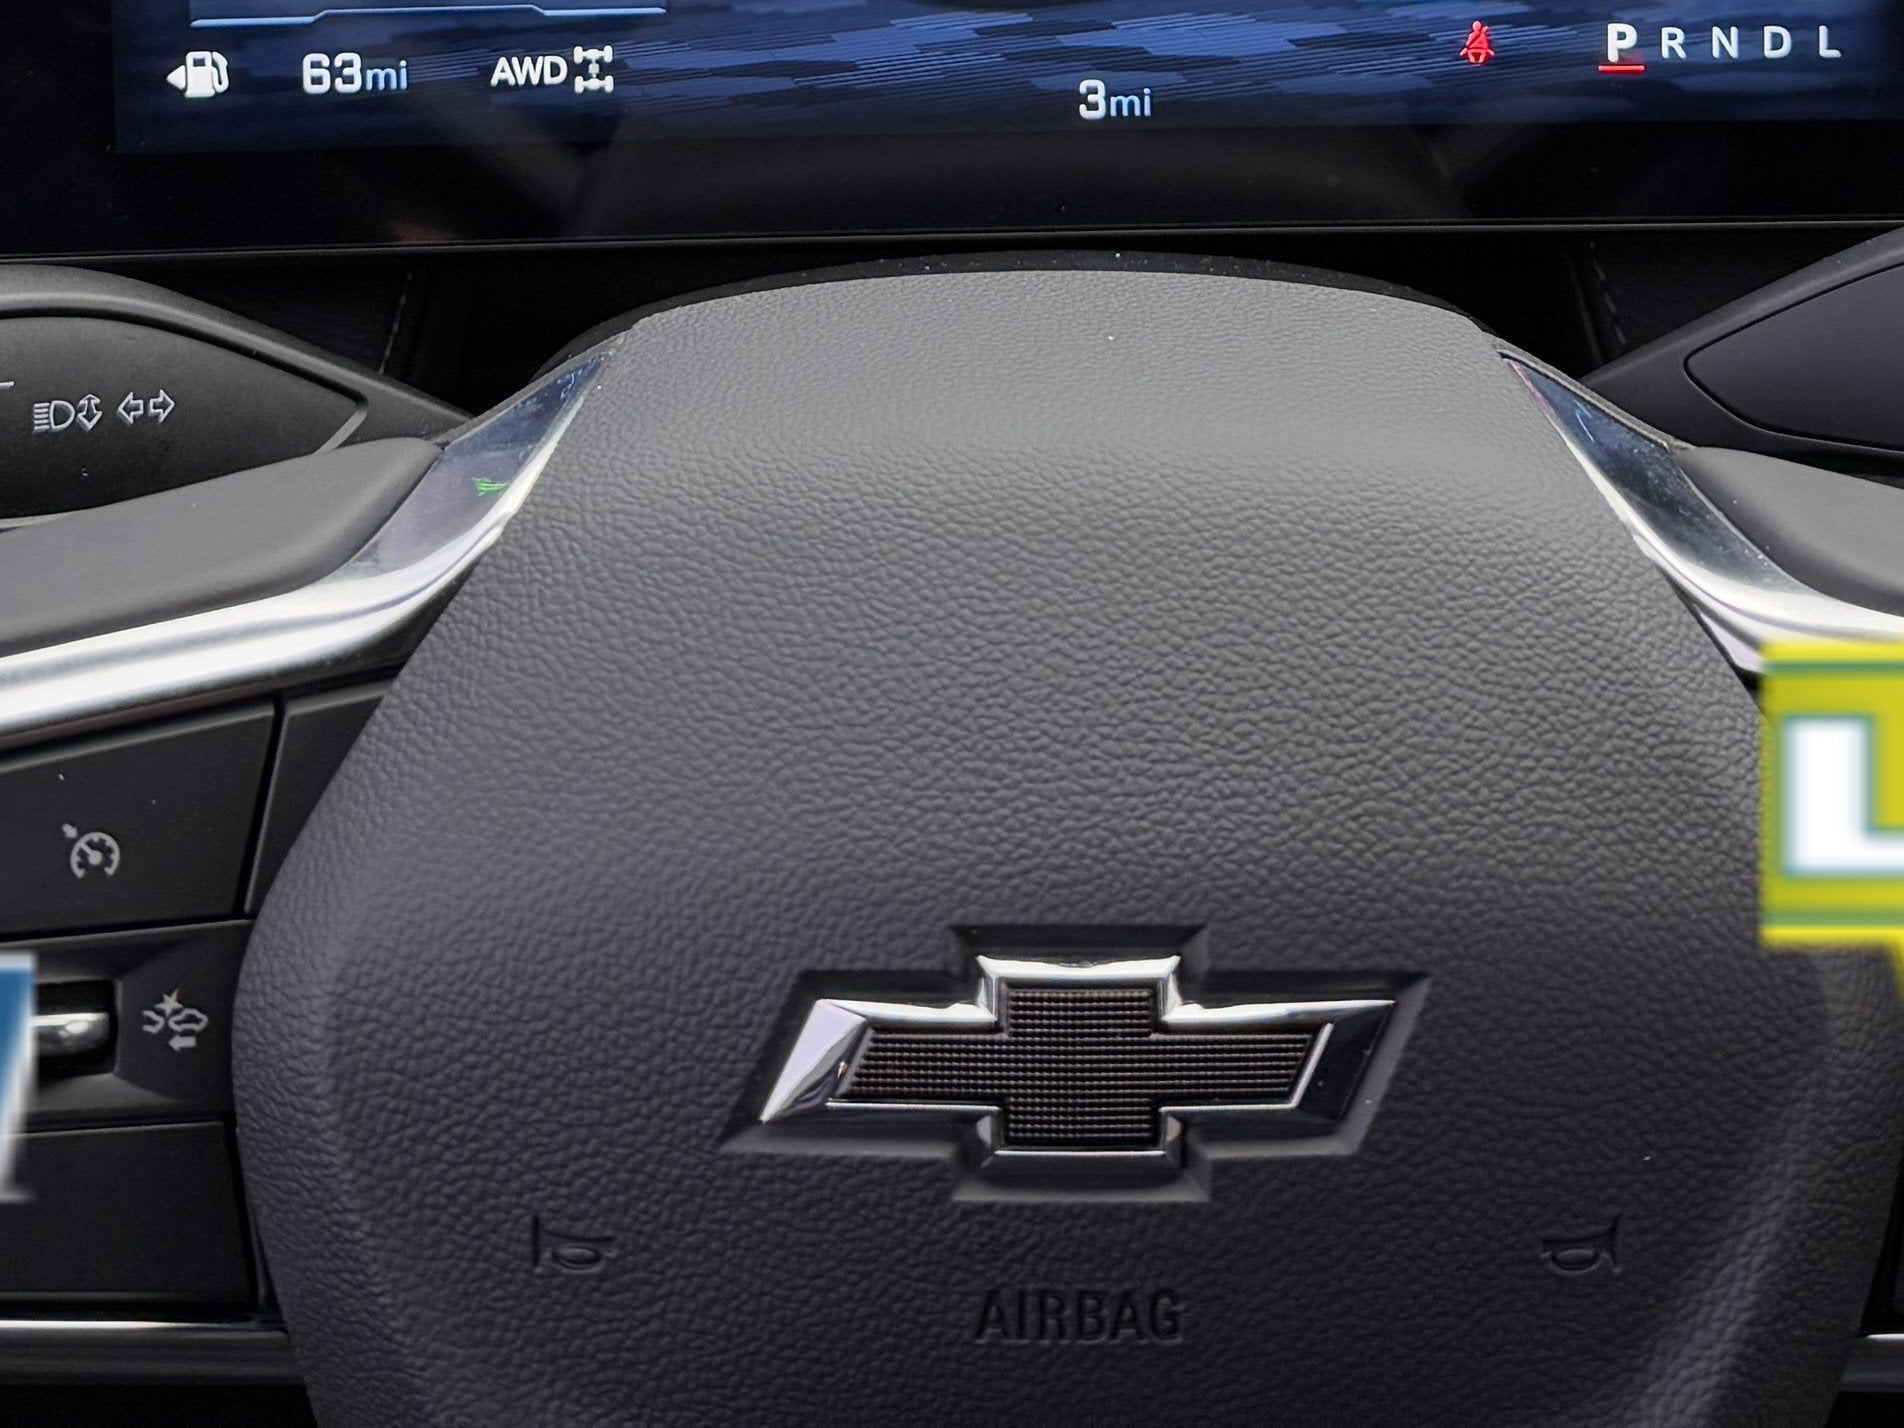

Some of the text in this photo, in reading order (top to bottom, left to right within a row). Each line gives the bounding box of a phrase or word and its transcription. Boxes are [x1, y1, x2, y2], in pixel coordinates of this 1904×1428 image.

[1607, 22, 1842, 63] P R N D L
[490, 54, 568, 88] AWD
[973, 1287, 1187, 1345] AIRBAG
